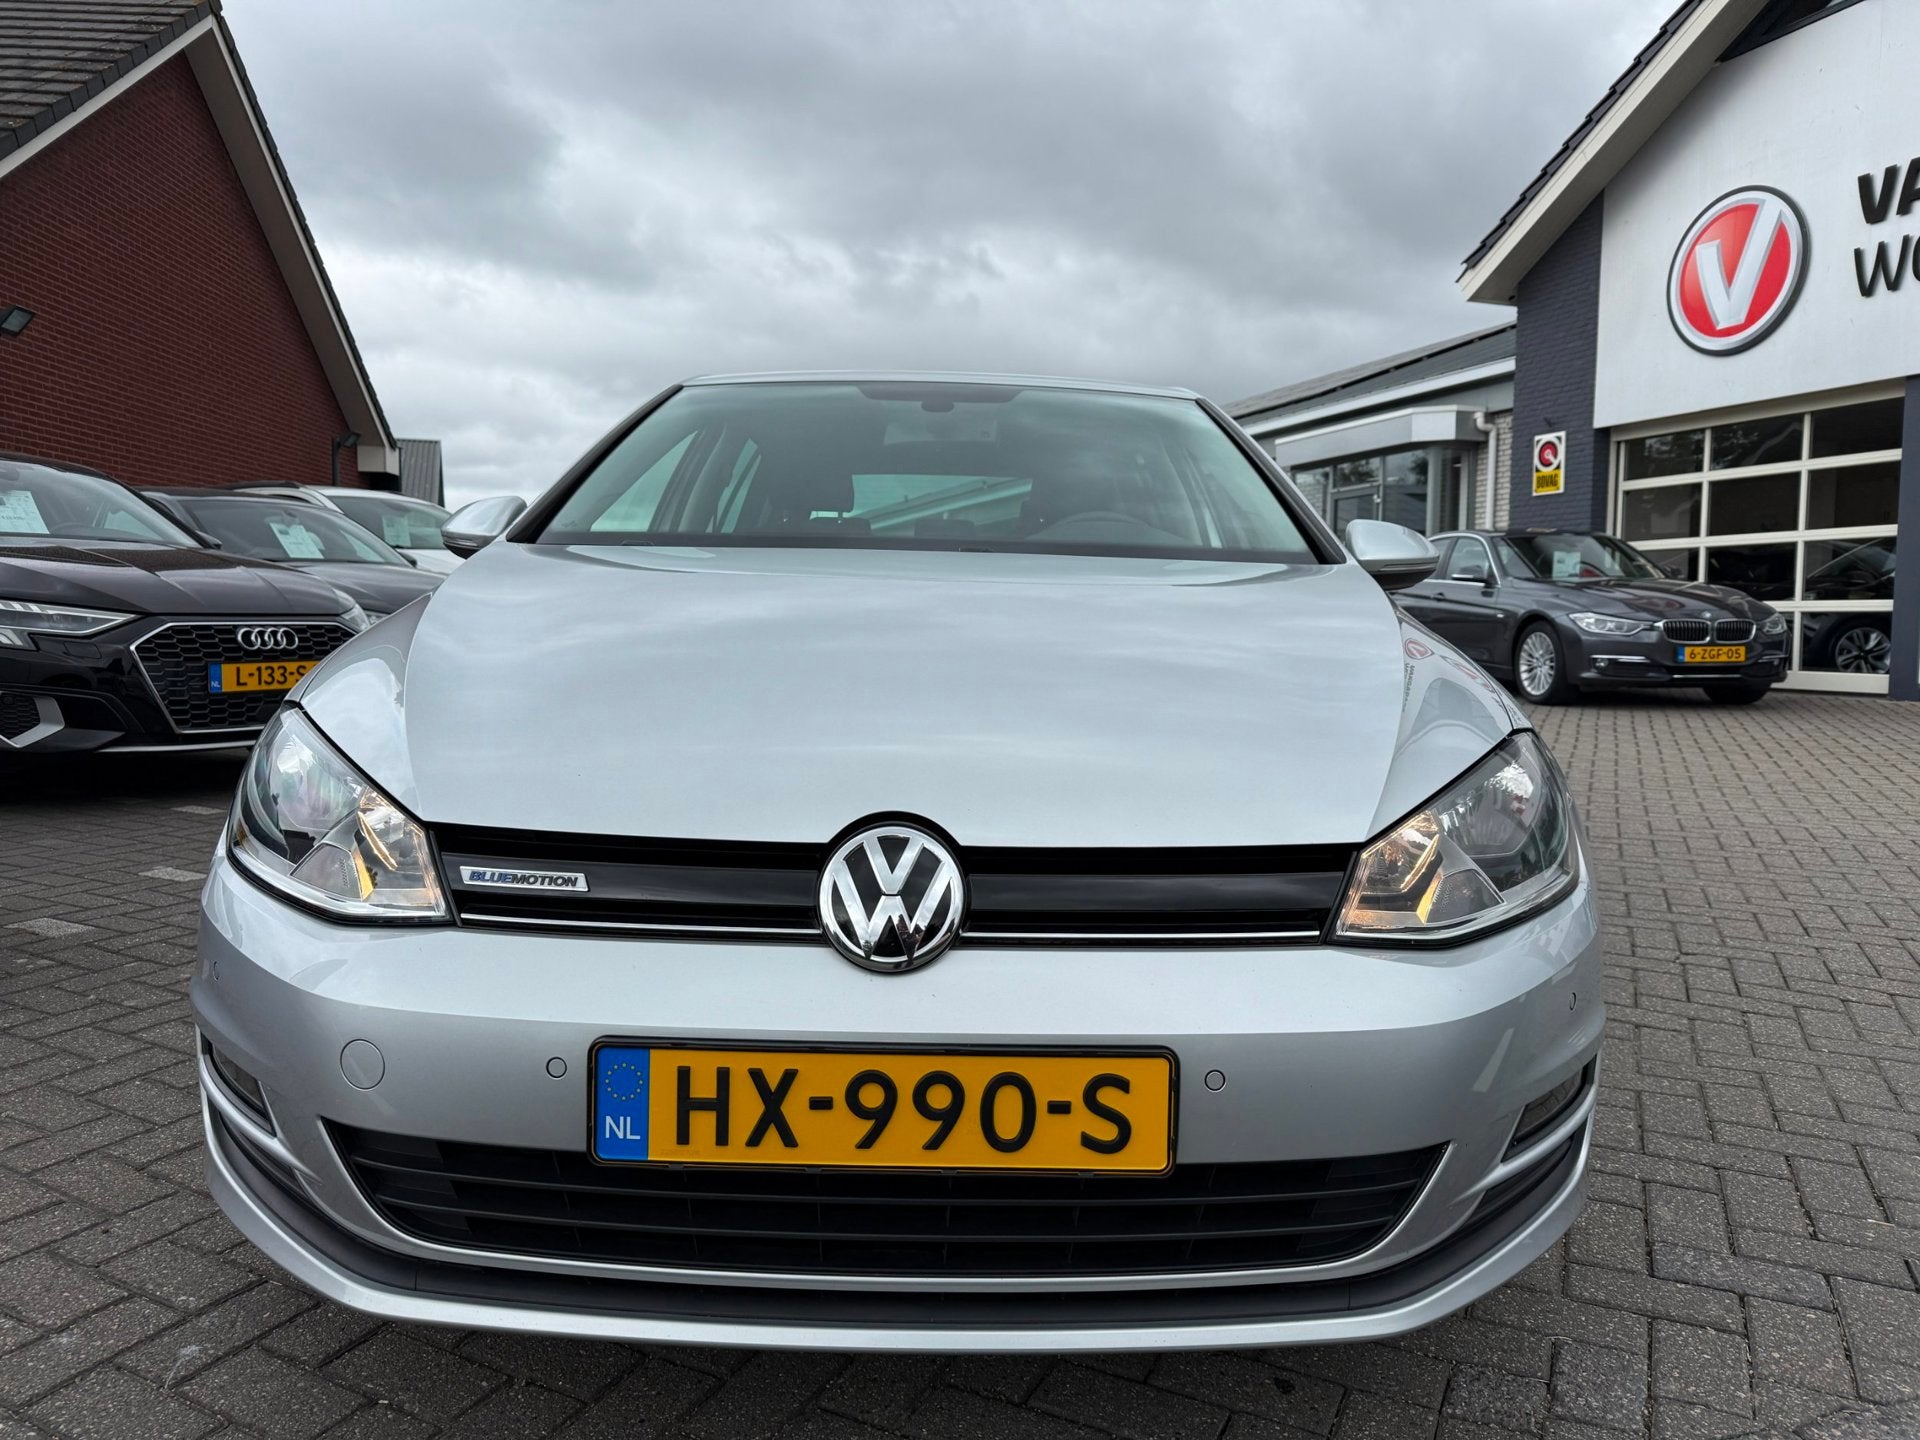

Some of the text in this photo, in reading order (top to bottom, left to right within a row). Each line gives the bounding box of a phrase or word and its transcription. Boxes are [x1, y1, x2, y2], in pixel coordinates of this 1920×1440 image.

[1854, 234, 1920, 298] W
[1536, 474, 1559, 489] BOVAG
[1689, 648, 1742, 660] 6-ZGF-05
[236, 664, 317, 687] L-133-S
[468, 870, 579, 887] BLUEMOTION
[675, 1065, 1132, 1155] HX-990-S
[605, 1115, 642, 1140] NL
